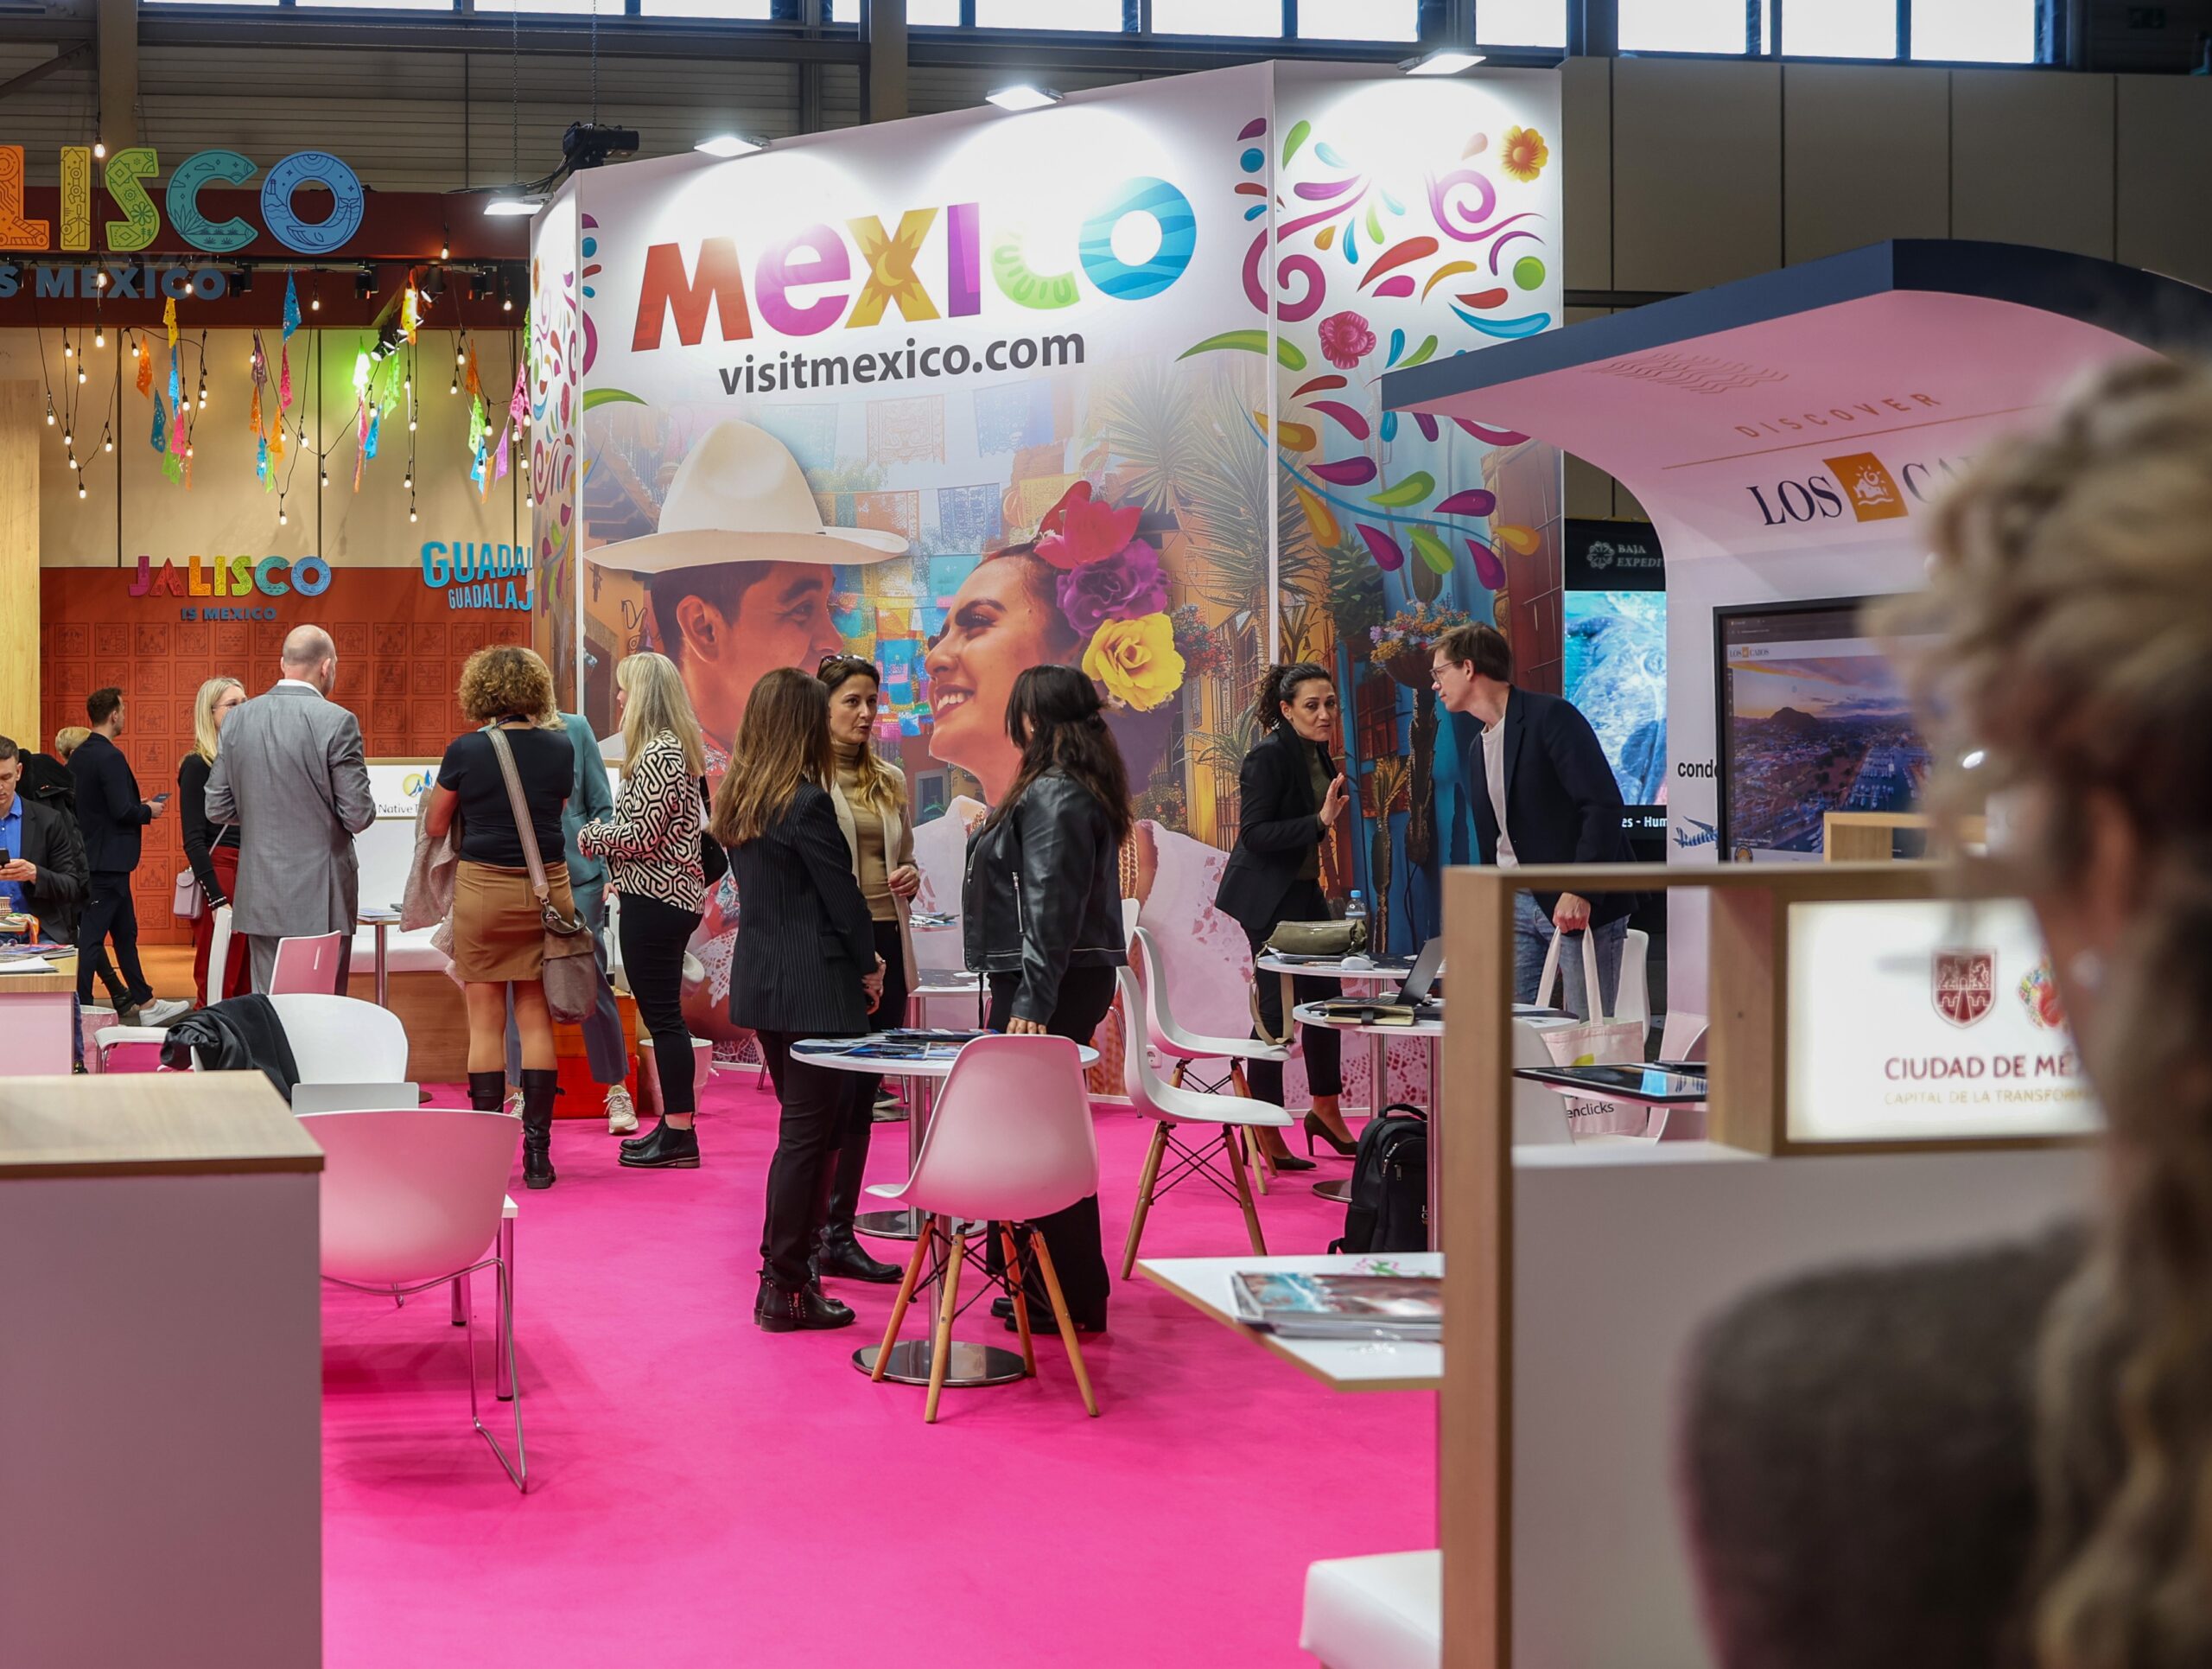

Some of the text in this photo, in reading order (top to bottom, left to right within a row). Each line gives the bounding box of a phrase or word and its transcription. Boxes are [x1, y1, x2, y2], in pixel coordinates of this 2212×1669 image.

[35, 267, 226, 300] MEXICO
[718, 332, 1085, 395] visitmexico.com
[1734, 393, 1942, 437] DISCOVER
[1745, 475, 1842, 526] LOS
[1617, 544, 1646, 555] BAJA
[1617, 557, 1665, 568] EXPEDI
[130, 555, 332, 596] JALISCO
[181, 608, 277, 621] IS MEXICO
[1677, 759, 1718, 778] cond
[378, 803, 413, 813] Native
[1885, 1057, 1985, 1080] CIUDAD
[1993, 1055, 2026, 1078] DE
[1884, 1092, 1942, 1105] CAPITAL
[1949, 1091, 1968, 1104] DE
[1974, 1090, 1990, 1103] LA
